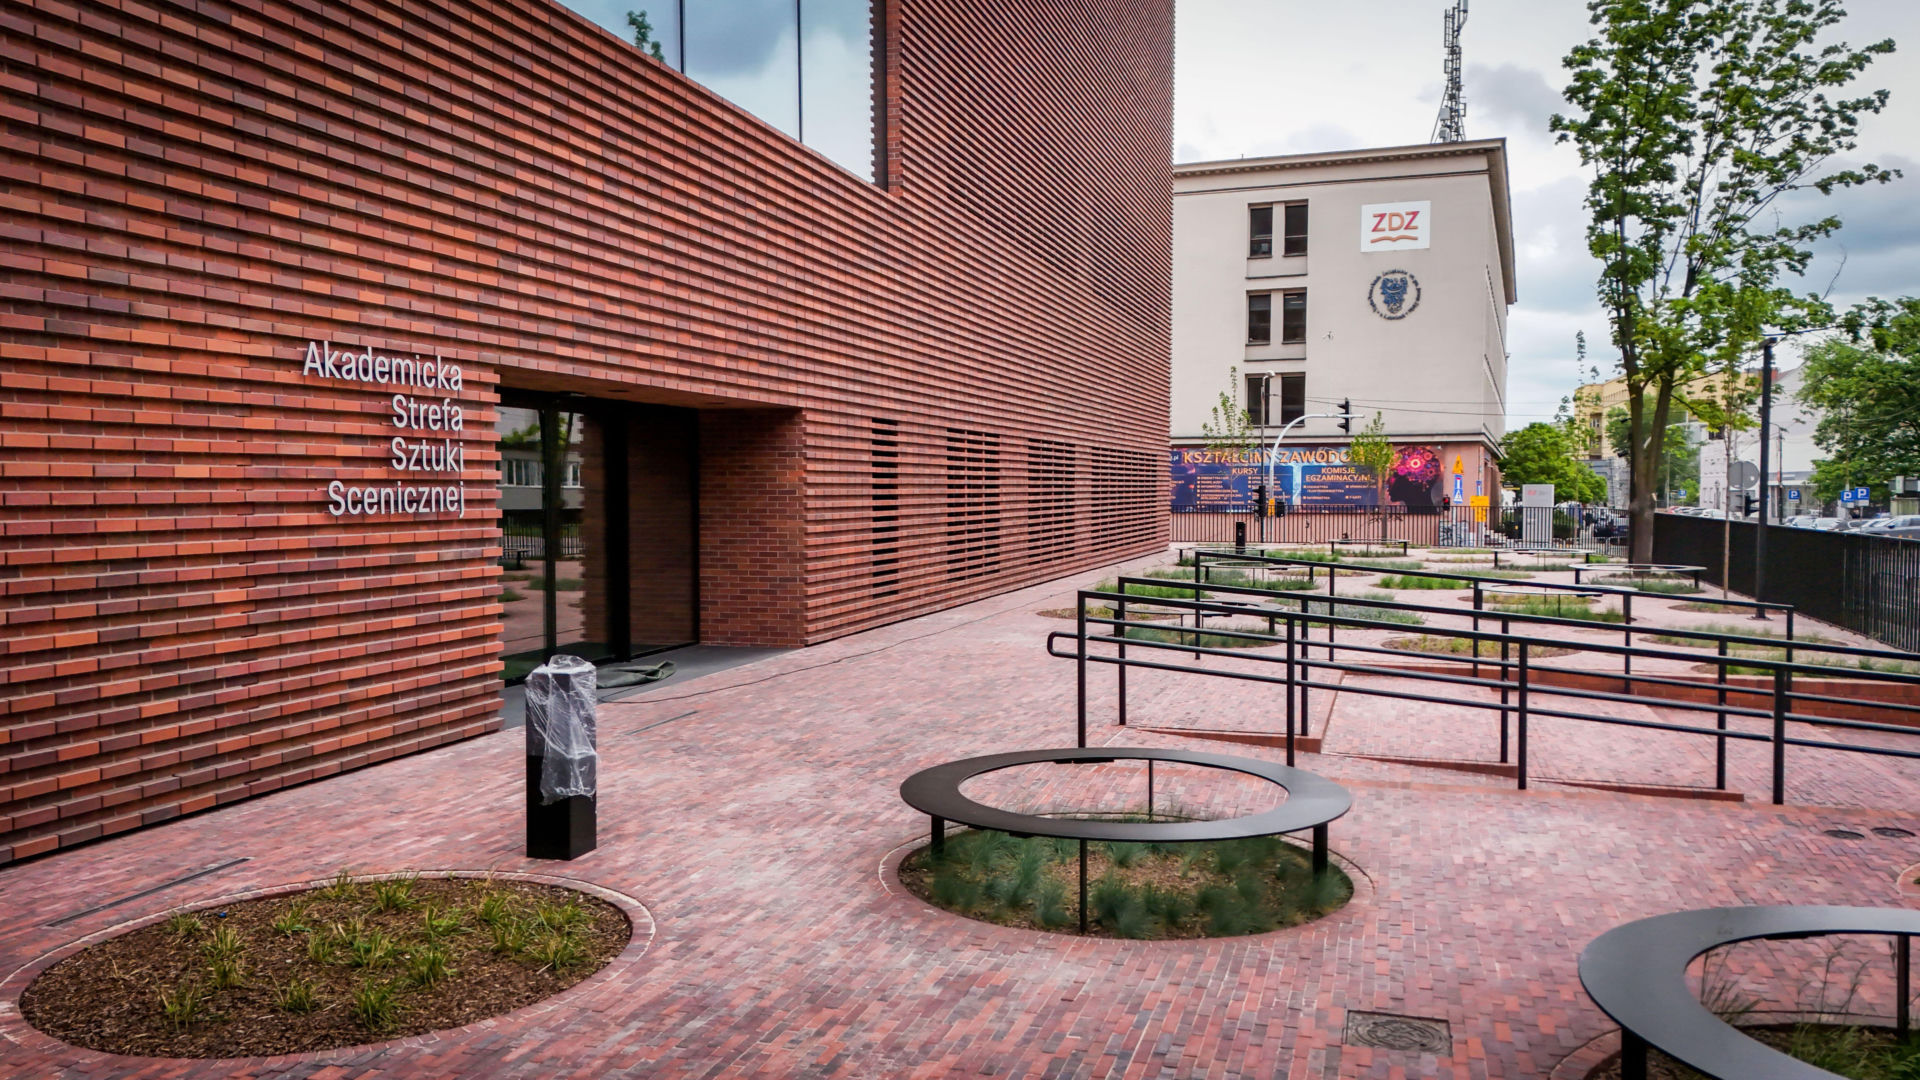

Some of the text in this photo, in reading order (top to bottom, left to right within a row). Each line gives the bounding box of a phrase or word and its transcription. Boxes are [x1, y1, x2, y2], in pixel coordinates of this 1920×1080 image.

[1371, 211, 1420, 232] ZDZ
[303, 340, 463, 391] Akademicka
[392, 394, 463, 432] Strefa
[391, 436, 464, 473] Sztuki
[1280, 450, 1364, 463] ZAWODO
[1232, 467, 1258, 475] KURSY
[328, 480, 465, 519] Scenicznej
[1790, 490, 1799, 499] P
[1843, 491, 1853, 501] P
[1857, 488, 1867, 499] P
